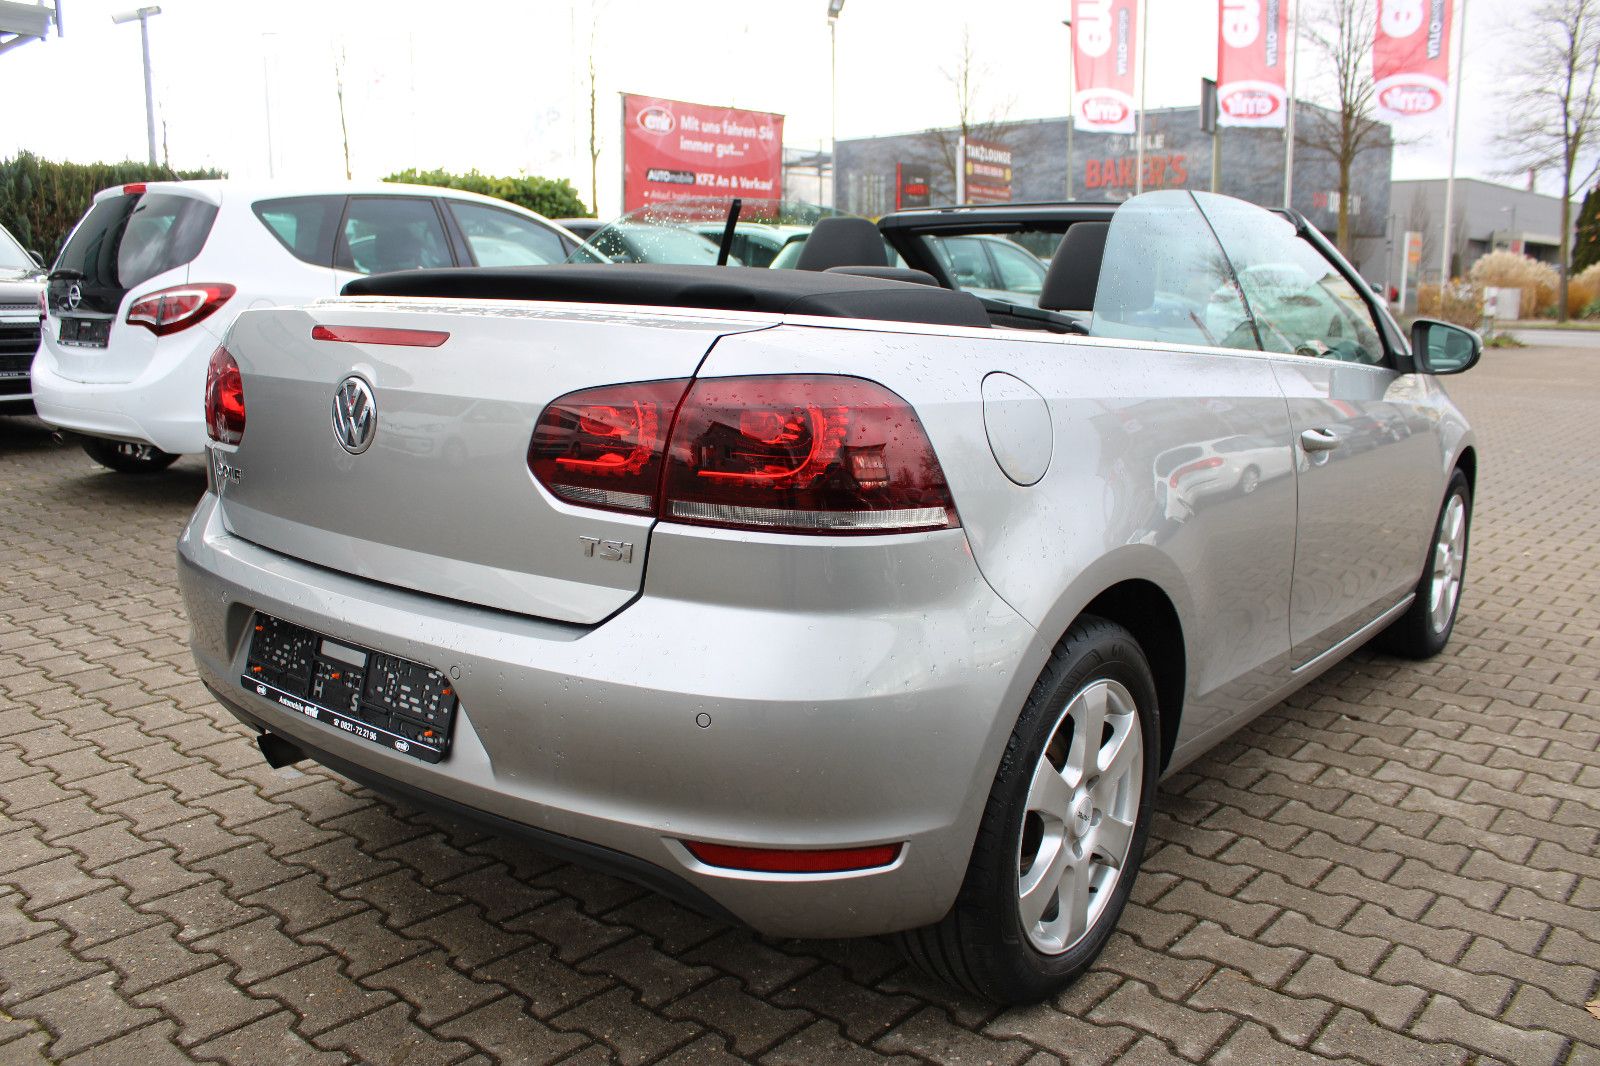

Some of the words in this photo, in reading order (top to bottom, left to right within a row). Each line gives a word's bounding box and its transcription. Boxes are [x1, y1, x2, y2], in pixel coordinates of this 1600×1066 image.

[680, 115, 699, 131] Mit
[701, 120, 720, 134] uns
[723, 120, 756, 139] fahren
[680, 136, 713, 152] immer
[696, 173, 715, 186] KFZ
[1085, 154, 1188, 189] BAKER'S
[580, 535, 634, 564] TSI
[279, 695, 304, 713] Automobile
[304, 705, 319, 719] emir
